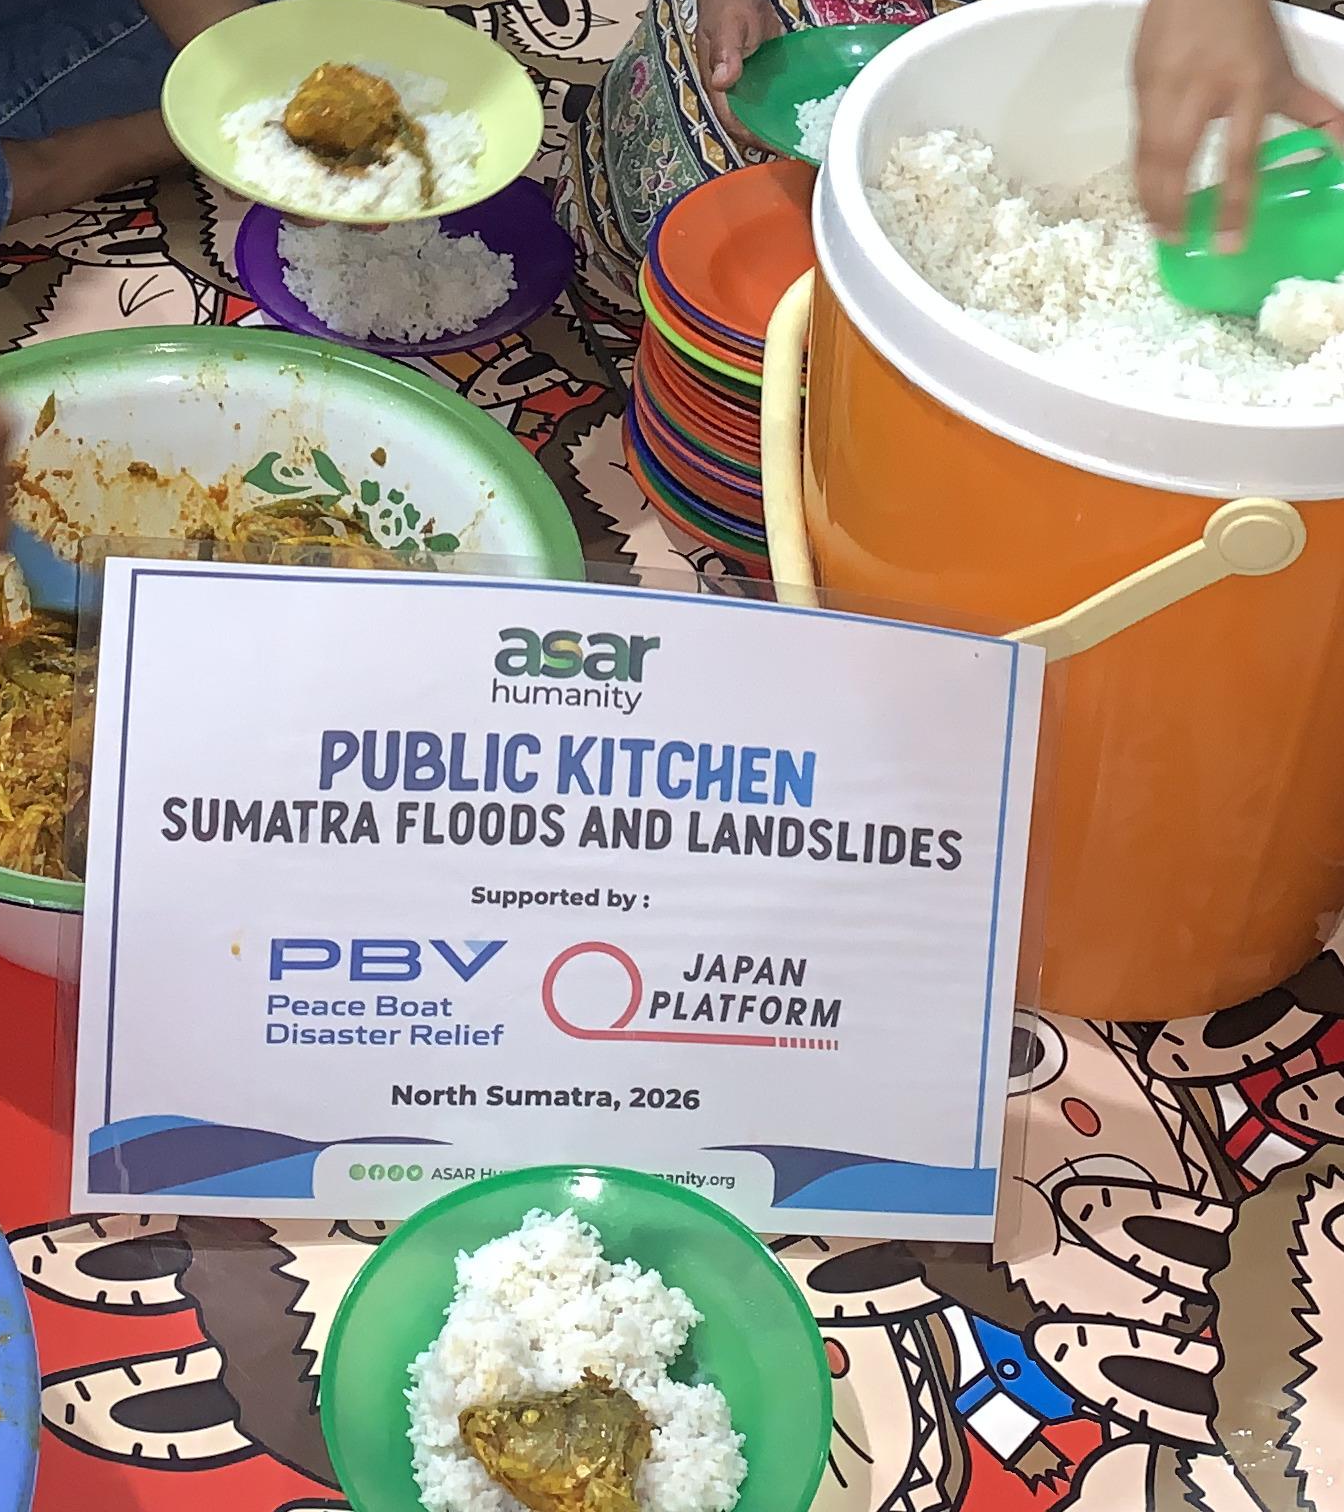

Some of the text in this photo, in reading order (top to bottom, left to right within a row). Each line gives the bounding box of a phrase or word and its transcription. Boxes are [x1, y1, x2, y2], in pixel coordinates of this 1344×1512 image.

[494, 627, 661, 683] asar
[491, 678, 643, 716] humanity
[318, 729, 817, 808] PUBLIC KITCHEN
[161, 796, 964, 871] SUMATRA FLOODS AND LANDSLIDES
[470, 885, 600, 909] Supported
[269, 937, 509, 983] PBV
[682, 952, 808, 988] JAPAN
[266, 994, 453, 1017] Peace Boat
[648, 989, 843, 1029] PLATFORM
[265, 1022, 505, 1046] Disaster Relief
[391, 1084, 701, 1112] North Sumatra, 2026
[431, 1167, 476, 1181] ASAR
[649, 1170, 736, 1190] anity.org
